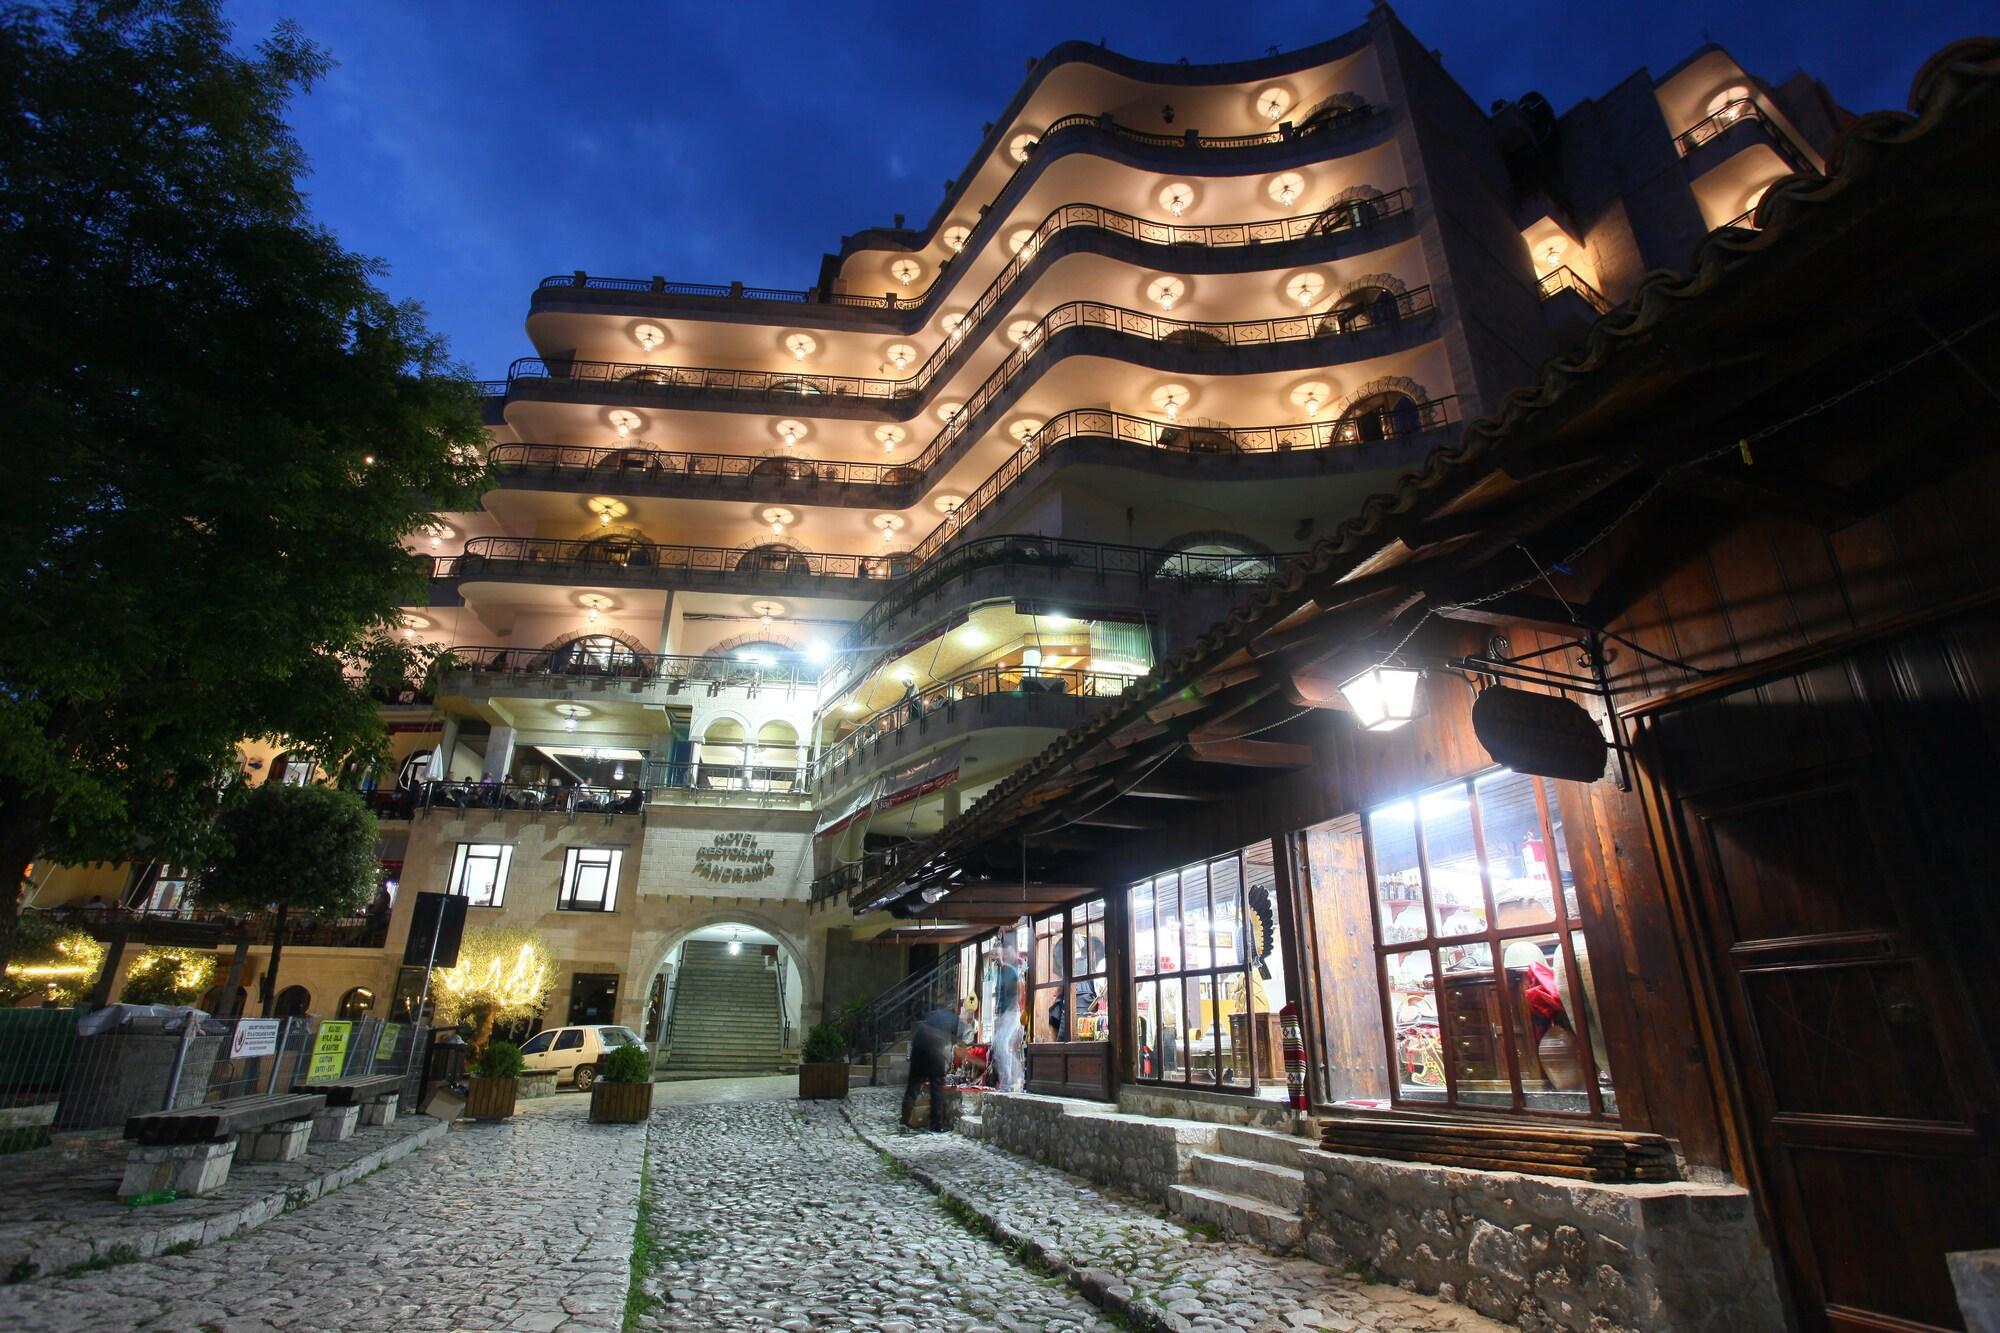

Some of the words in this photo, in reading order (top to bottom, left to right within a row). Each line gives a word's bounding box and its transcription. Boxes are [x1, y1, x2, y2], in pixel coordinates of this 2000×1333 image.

[714, 832, 757, 847] HOTEL
[697, 847, 774, 861] RESTORANT
[692, 858, 775, 882] PANORAMA
